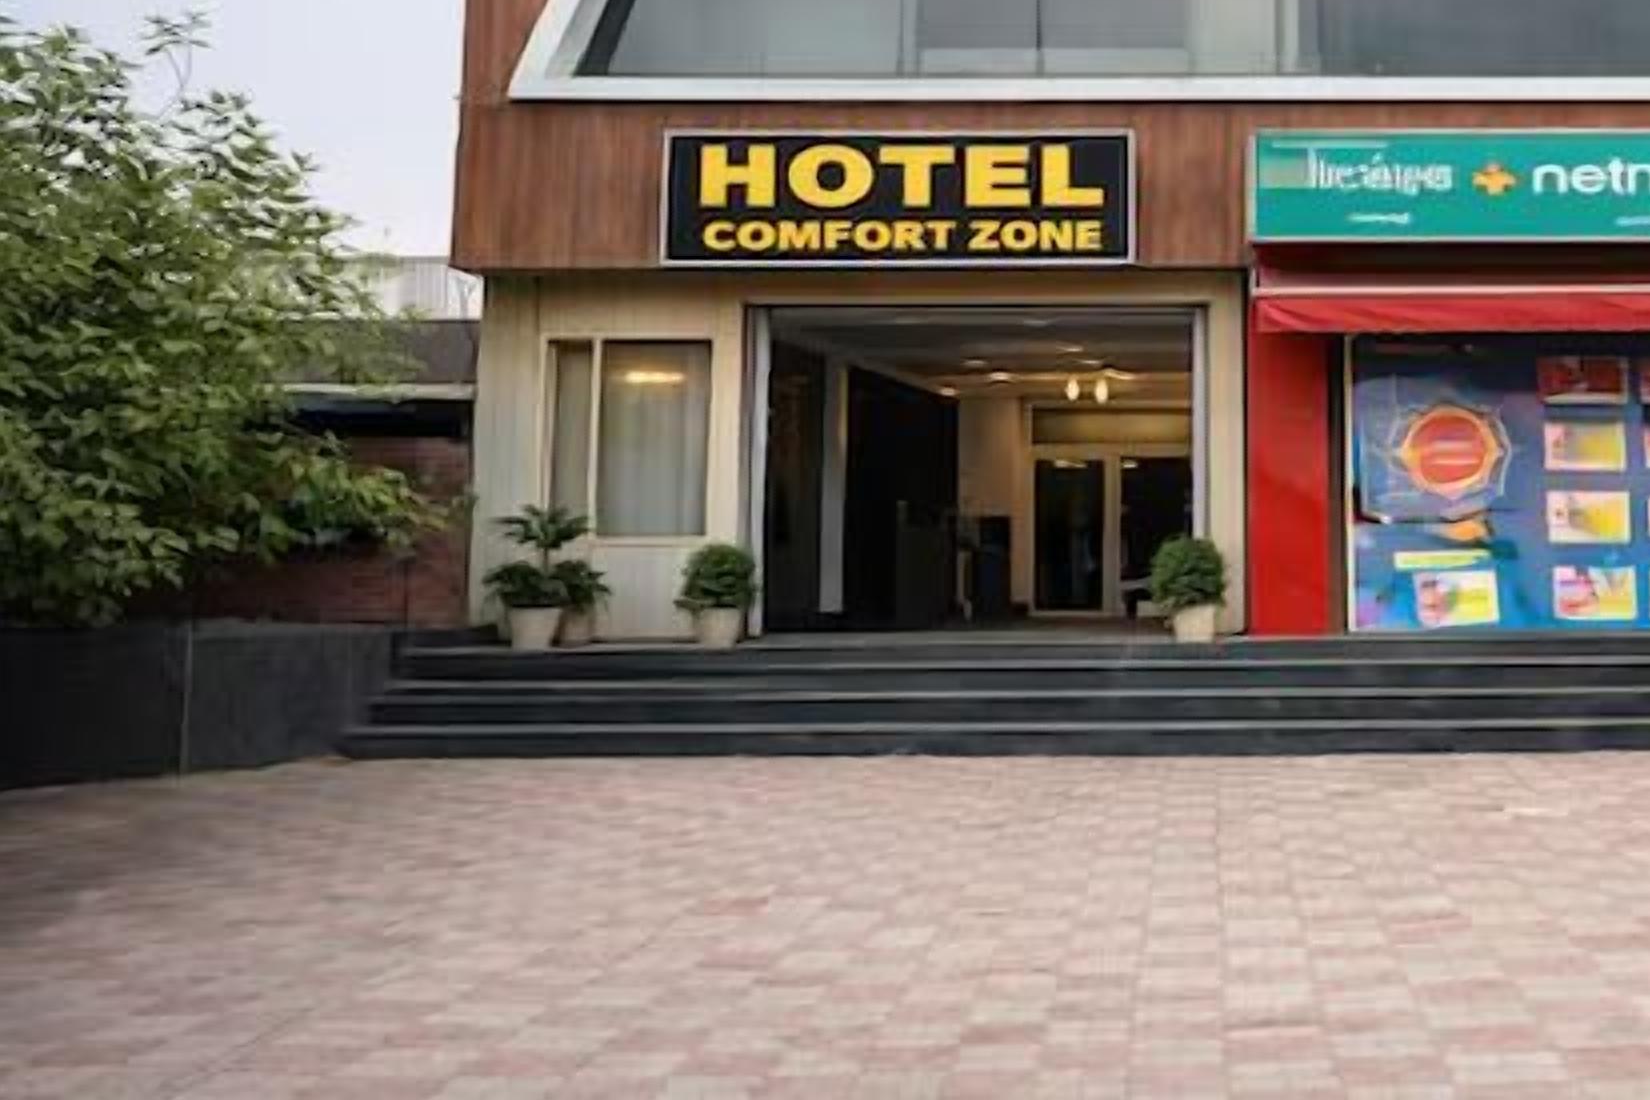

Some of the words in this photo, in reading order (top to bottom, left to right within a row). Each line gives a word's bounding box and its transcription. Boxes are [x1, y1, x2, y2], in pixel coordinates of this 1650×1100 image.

[700, 143, 1105, 208] HOTEL
[703, 219, 957, 252] COMFORT
[967, 219, 1102, 252] ZONE
